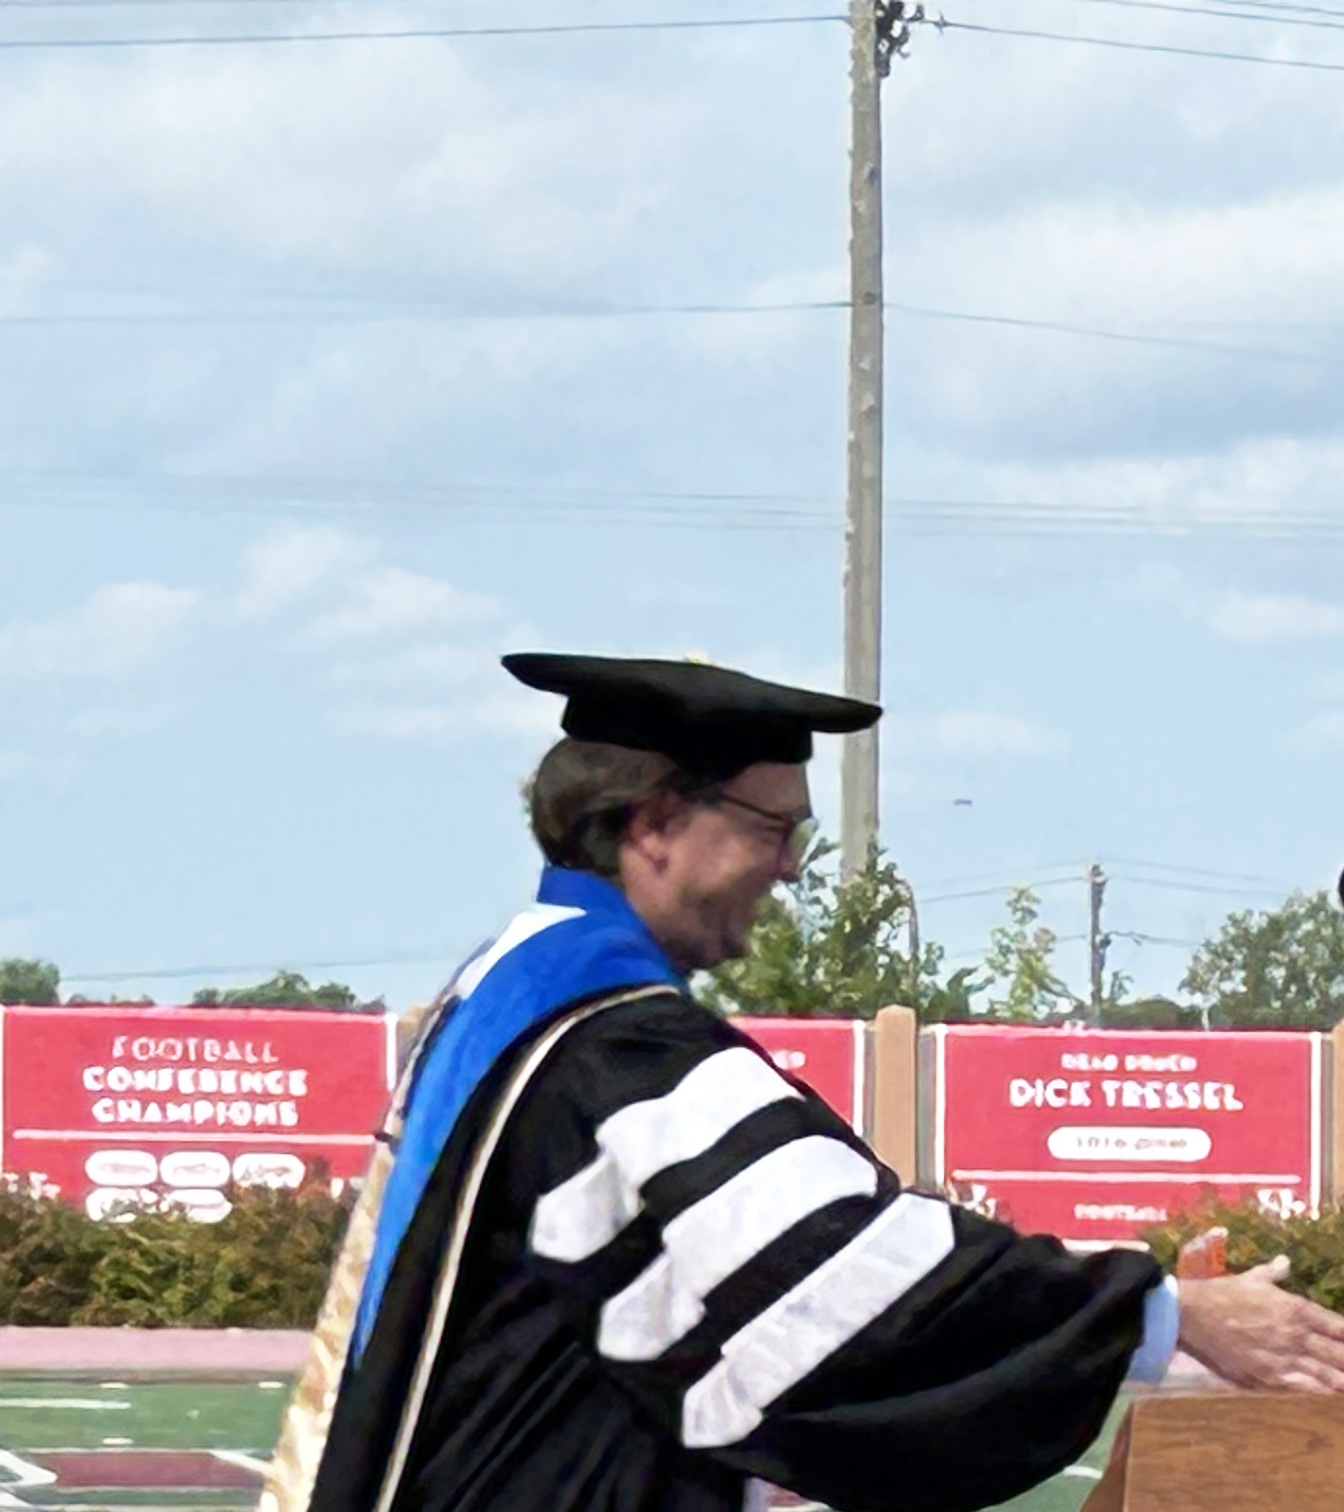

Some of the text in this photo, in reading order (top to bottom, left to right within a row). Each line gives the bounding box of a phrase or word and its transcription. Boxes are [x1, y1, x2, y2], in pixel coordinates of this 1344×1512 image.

[111, 1035, 279, 1064] FOOTBALL
[82, 1066, 308, 1096] CONFERENCE
[1009, 1078, 1244, 1111] DICK TRESSEL
[91, 1097, 299, 1127] CHAMPIONS
